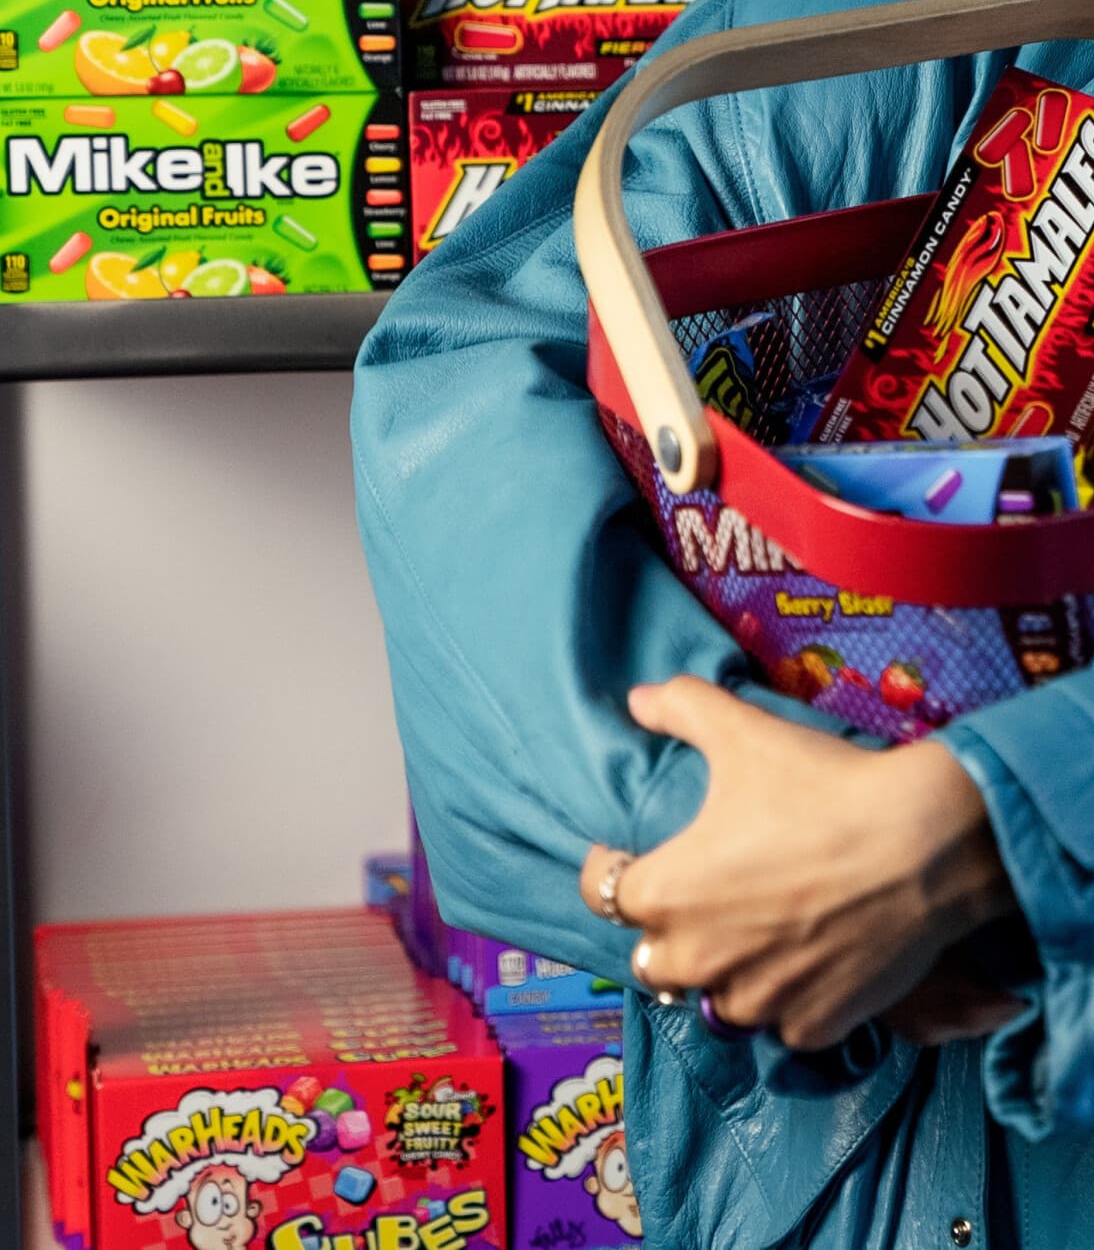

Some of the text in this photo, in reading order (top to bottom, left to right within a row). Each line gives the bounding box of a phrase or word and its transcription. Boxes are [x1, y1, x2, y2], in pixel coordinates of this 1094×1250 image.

[533, 100, 590, 112] CINNA
[8, 136, 203, 194] Mike
[226, 142, 339, 197] Ike
[99, 206, 265, 232] Original Fruits
[5, 254, 26, 270] 110
[881, 167, 972, 337] CINNAMON CANDY
[905, 338, 1014, 442] HOT
[819, 397, 848, 442] GLUTEN FREE
[838, 415, 853, 435] FREE
[775, 591, 835, 623] Berry
[403, 1101, 462, 1121] SOUR
[518, 1073, 624, 1166] WARH
[403, 1121, 463, 1137] SWEET
[404, 1136, 460, 1150] FRUITY
[107, 1107, 308, 1200] WARHEADS
